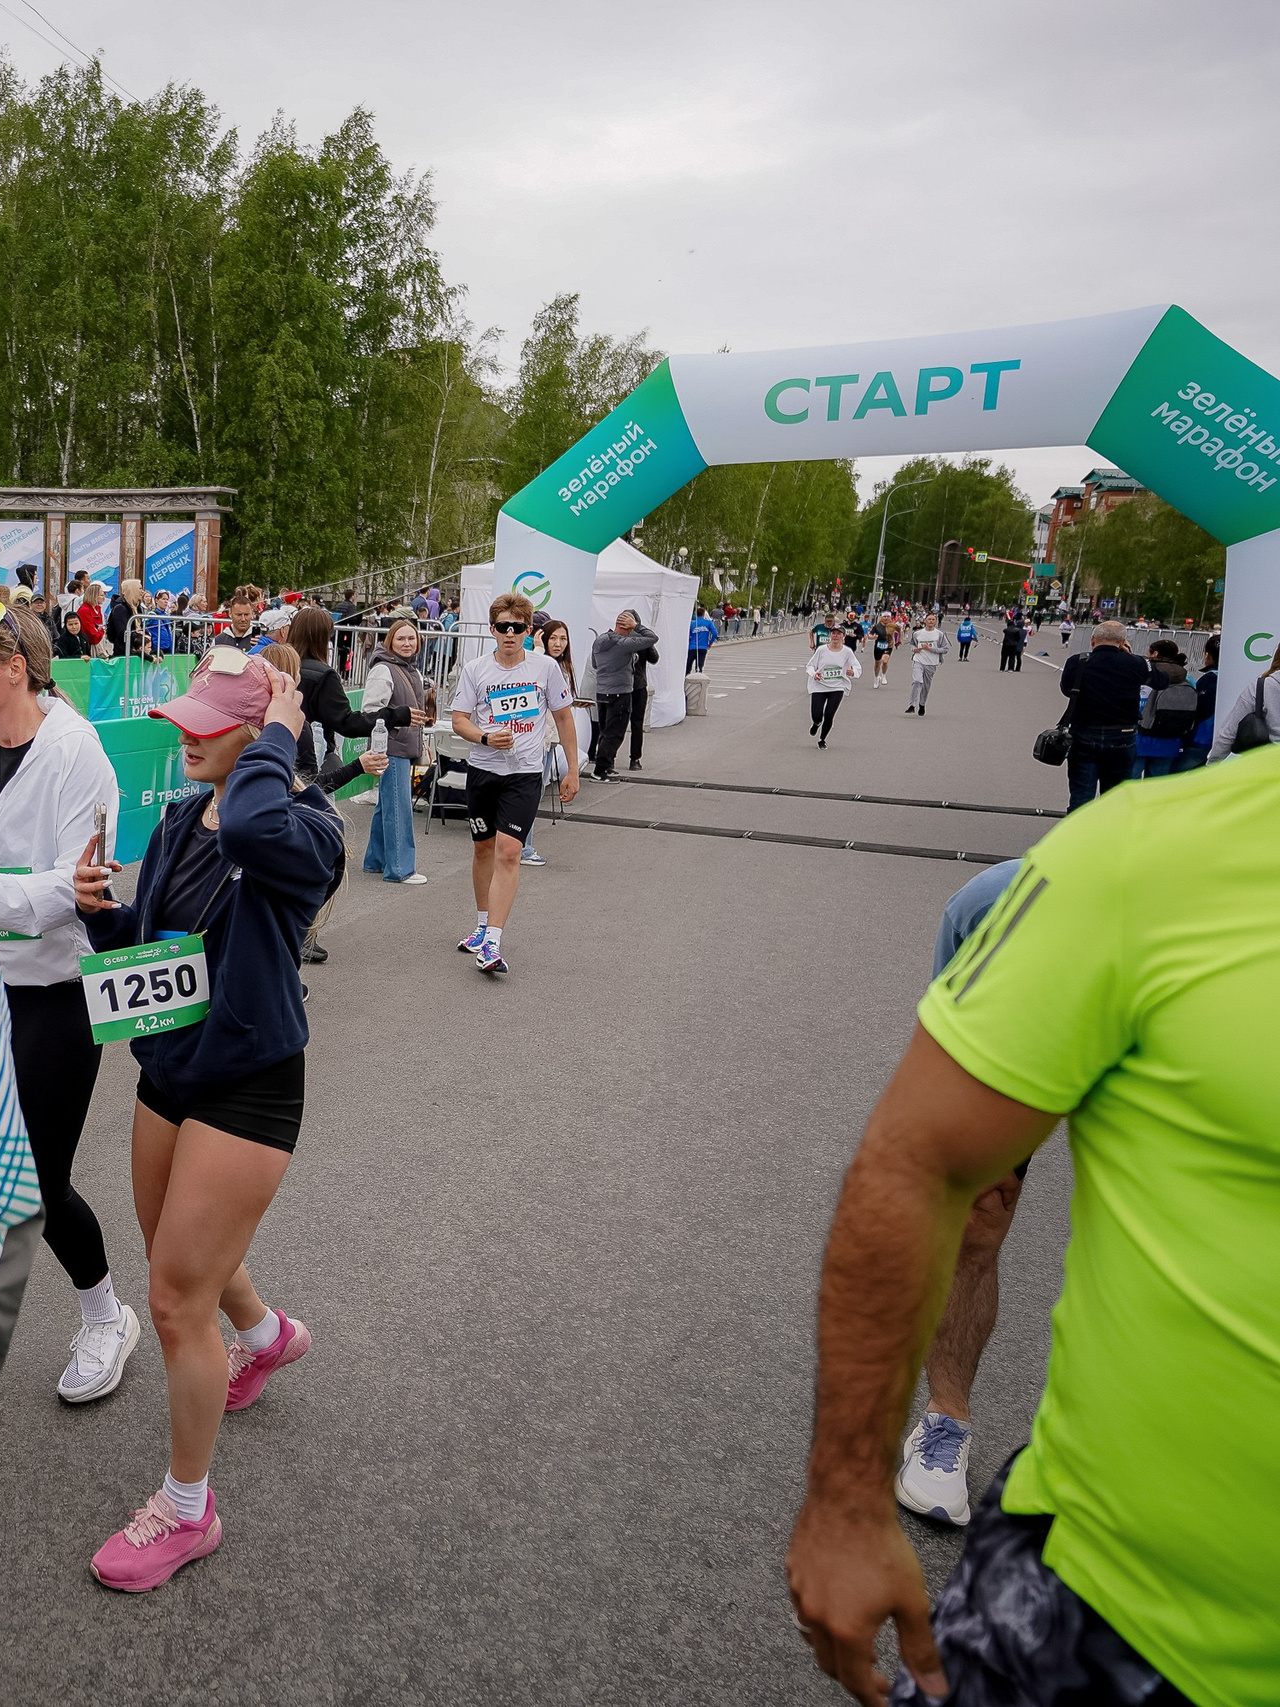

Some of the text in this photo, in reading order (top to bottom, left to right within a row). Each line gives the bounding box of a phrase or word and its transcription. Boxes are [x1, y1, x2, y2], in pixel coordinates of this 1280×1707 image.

[764, 359, 1021, 424] СТАРТ
[1177, 382, 1280, 465] зелёны
[558, 421, 645, 501] зелёный
[1150, 401, 1277, 493] марафон
[569, 438, 658, 517] марафон
[0, 528, 22, 543] БЫТЬ
[148, 554, 192, 585] ПЕРВЫХ
[151, 543, 190, 572] ДВИЖЕНИЕ
[500, 695, 529, 711] 573
[141, 783, 200, 806] В твоём
[111, 955, 129, 964] СБЕР
[99, 963, 198, 1013] 1250
